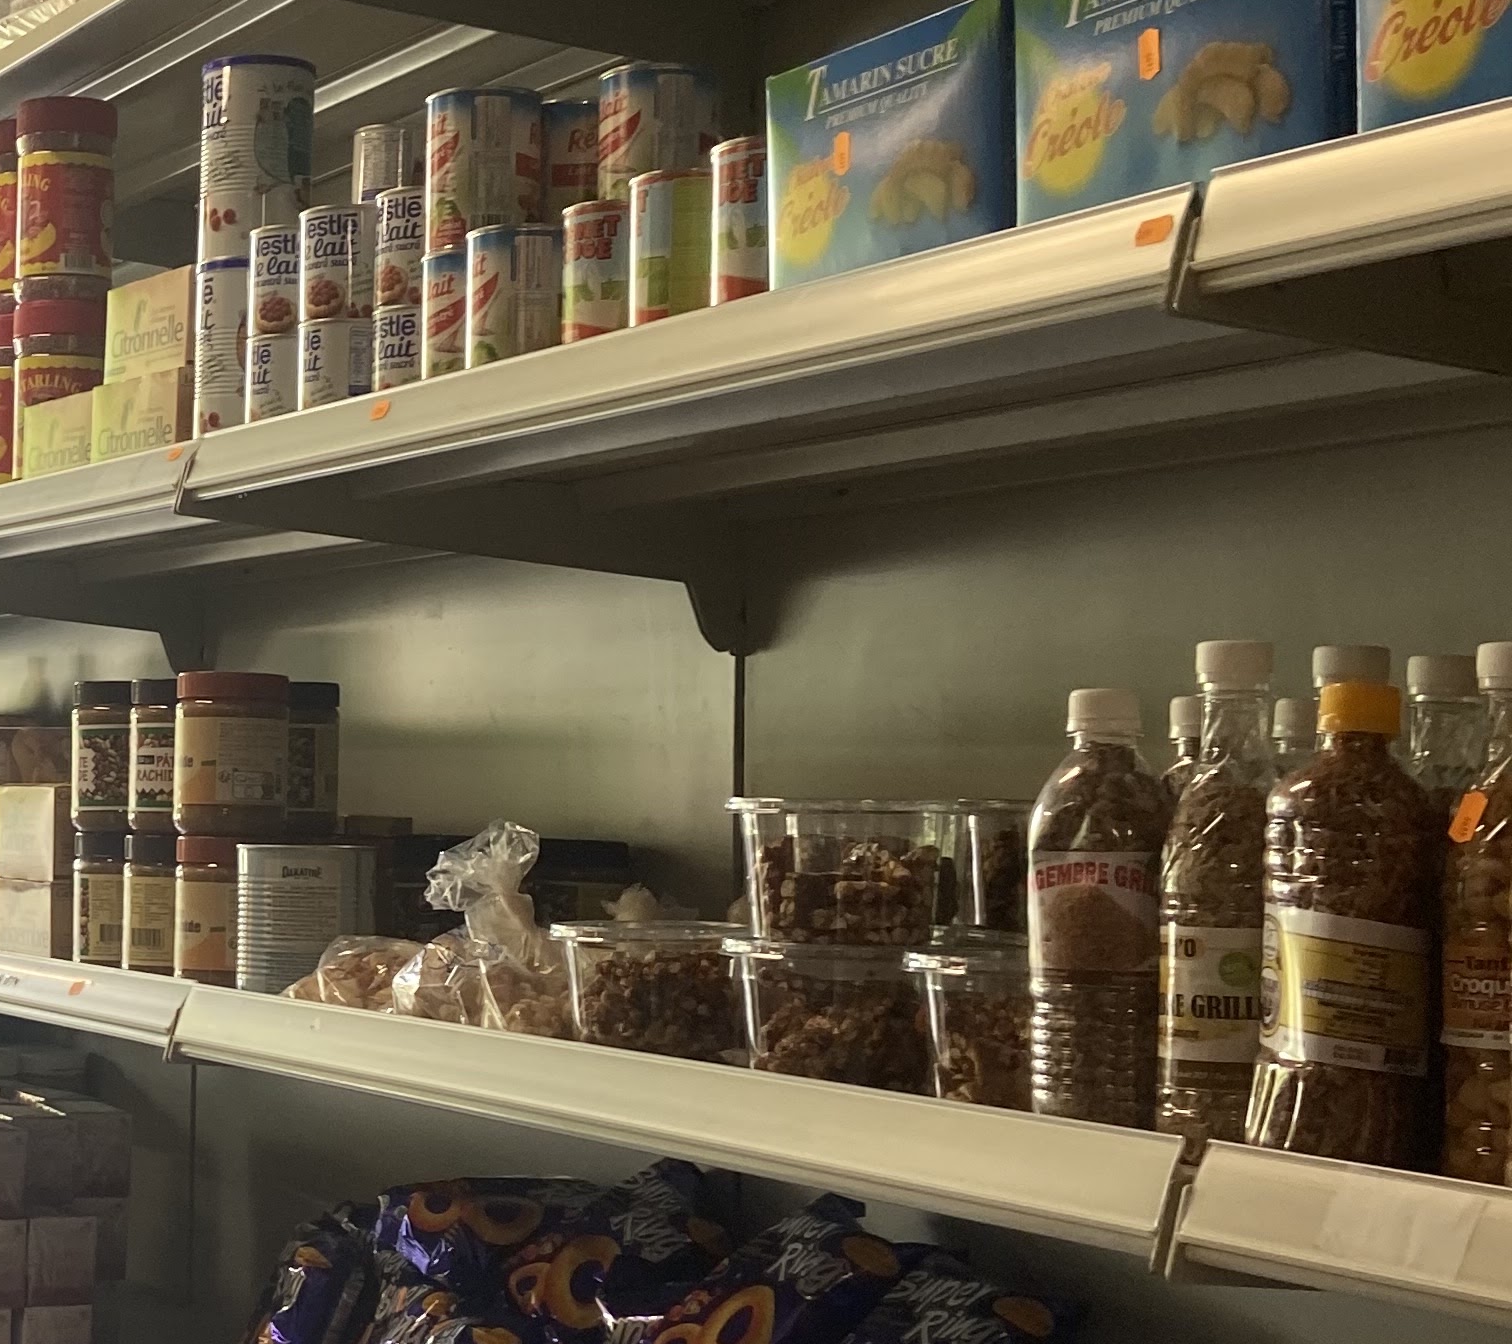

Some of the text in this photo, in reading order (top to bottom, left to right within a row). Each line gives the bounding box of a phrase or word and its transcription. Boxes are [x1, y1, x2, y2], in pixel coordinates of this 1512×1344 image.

[803, 37, 960, 123] TAMARIN SUCRE
[1022, 90, 1128, 179] Créole
[306, 212, 359, 240] estlé
[257, 234, 298, 258] estl
[313, 236, 362, 259] lait
[266, 256, 299, 276] lai
[111, 313, 185, 358] Citronnelle
[21, 373, 83, 394] TARLING
[96, 415, 174, 457] Citronnelle
[136, 768, 175, 784] RACHID
[1034, 860, 1111, 892] GEMBRE
[1448, 972, 1512, 999] Croqu
[765, 1241, 855, 1301] Ring
[883, 1269, 1000, 1313] Super
